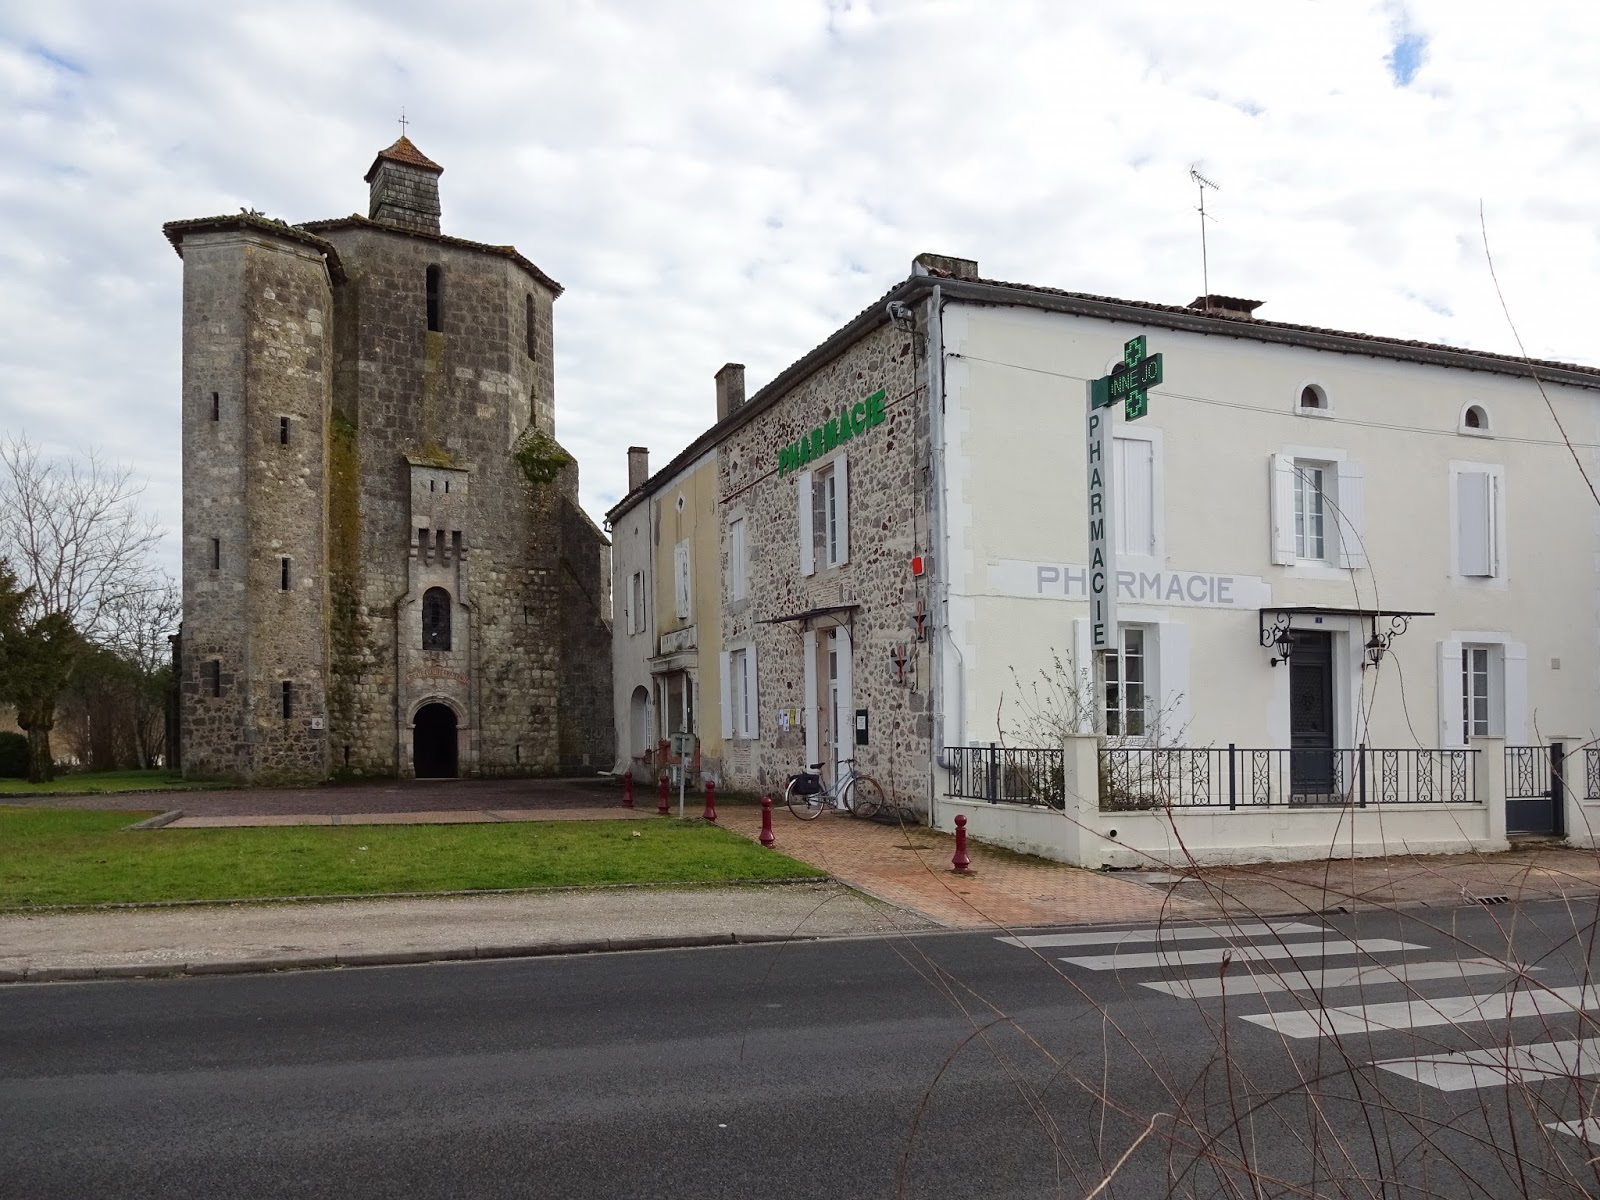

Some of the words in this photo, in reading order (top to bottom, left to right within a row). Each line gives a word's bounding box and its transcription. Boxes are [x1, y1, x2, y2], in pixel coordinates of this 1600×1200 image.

[778, 388, 886, 479] PHARMACIE
[1089, 415, 1105, 645] PHARMACIE
[1037, 566, 1234, 604] PHRMACIE
